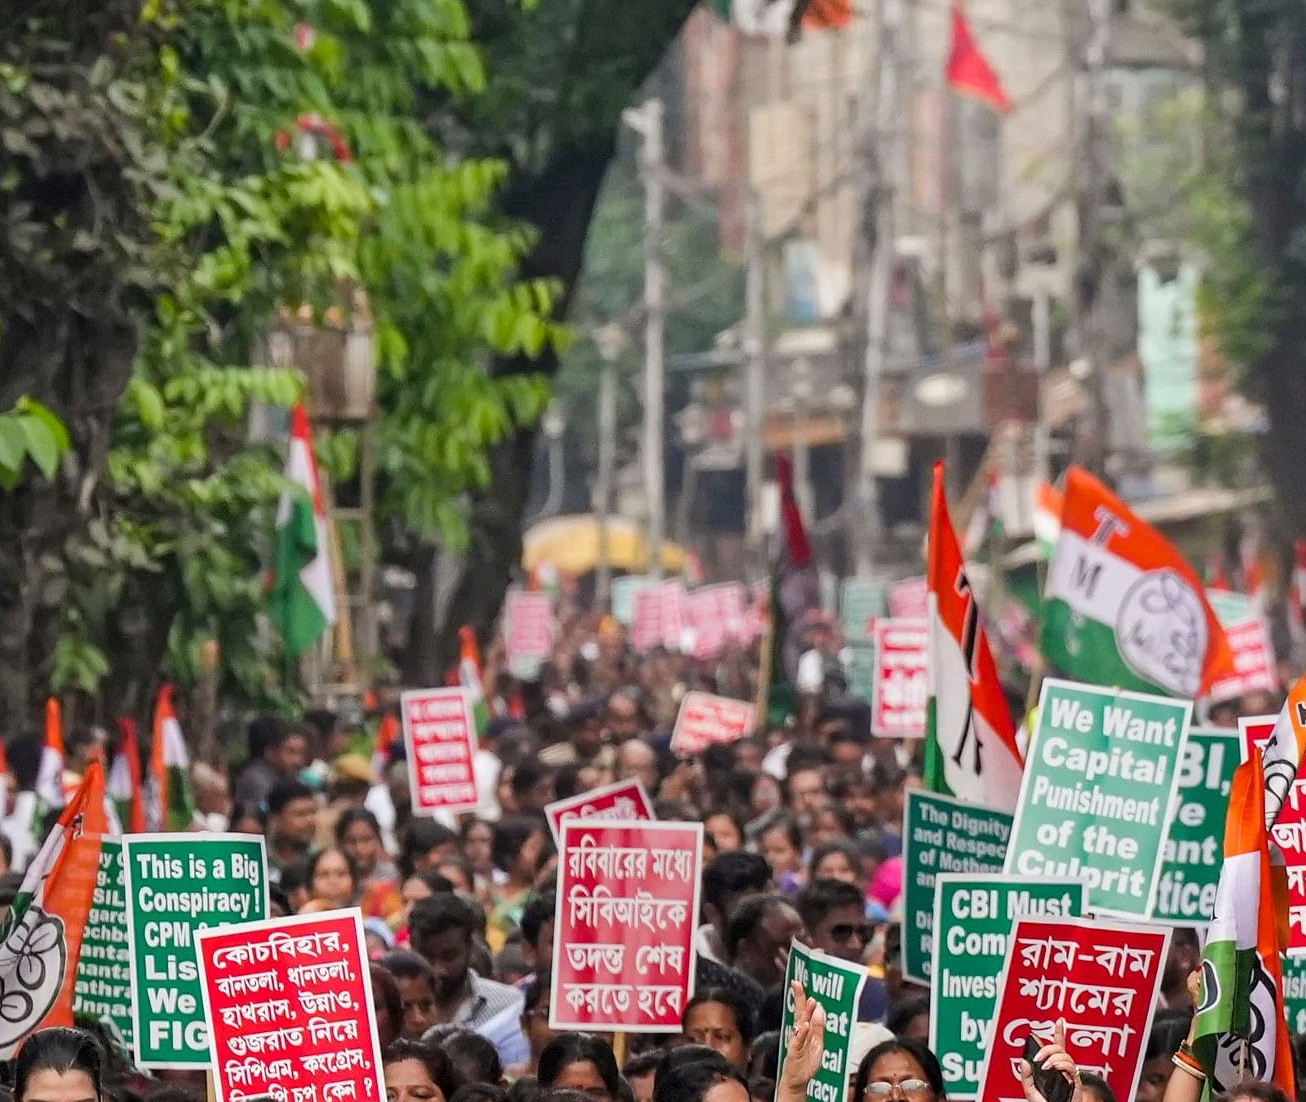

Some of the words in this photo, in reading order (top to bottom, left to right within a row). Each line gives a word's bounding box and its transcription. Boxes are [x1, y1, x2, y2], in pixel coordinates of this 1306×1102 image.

[1049, 697, 1093, 732] We
[1101, 706, 1177, 747] Want
[1041, 736, 1169, 785] Capital
[1179, 742, 1232, 797] BI,
[1031, 775, 1161, 826] Punishment
[919, 802, 949, 827] The
[951, 811, 1009, 842] Dignity
[1036, 820, 1075, 848] of
[1083, 825, 1139, 860] the
[567, 834, 648, 880] রবিবারের
[652, 846, 692, 883] মধ্যে
[913, 827, 943, 848] and
[946, 832, 1006, 859] Respec
[919, 849, 935, 866] of
[1163, 836, 1219, 865] ant
[136, 853, 183, 879] This
[188, 853, 206, 879] is
[212, 859, 225, 879] a
[231, 852, 260, 886] Big
[138, 886, 251, 919] Conspiracy
[568, 884, 687, 932] সিবিআইকে
[952, 889, 998, 919] CBI
[1007, 891, 1073, 919] Must
[1158, 870, 1218, 917] tice
[144, 921, 191, 948] CPM
[212, 932, 350, 969] কোচবিহার,
[565, 943, 625, 974] তদন্ত
[635, 941, 685, 976] শেষ
[1017, 935, 1156, 978] রাম-বাম
[215, 969, 284, 998] বানতলা,
[287, 959, 355, 988] ধানতলা,
[812, 971, 844, 1001] will
[1018, 975, 1138, 1018] শ্যামের
[147, 988, 197, 1014] We
[220, 998, 297, 1029] হাথরাস,
[298, 987, 359, 1015] উন্নাও,
[563, 982, 633, 1015] করতে
[636, 983, 683, 1019] হবে
[227, 1026, 304, 1057] গুজরাত
[307, 1017, 358, 1045] নিয়ে
[961, 1011, 991, 1050] by
[225, 1057, 298, 1088] সিপিএম,
[300, 1049, 371, 1076] কংগ্রেস,
[323, 1079, 356, 1102] কেন
